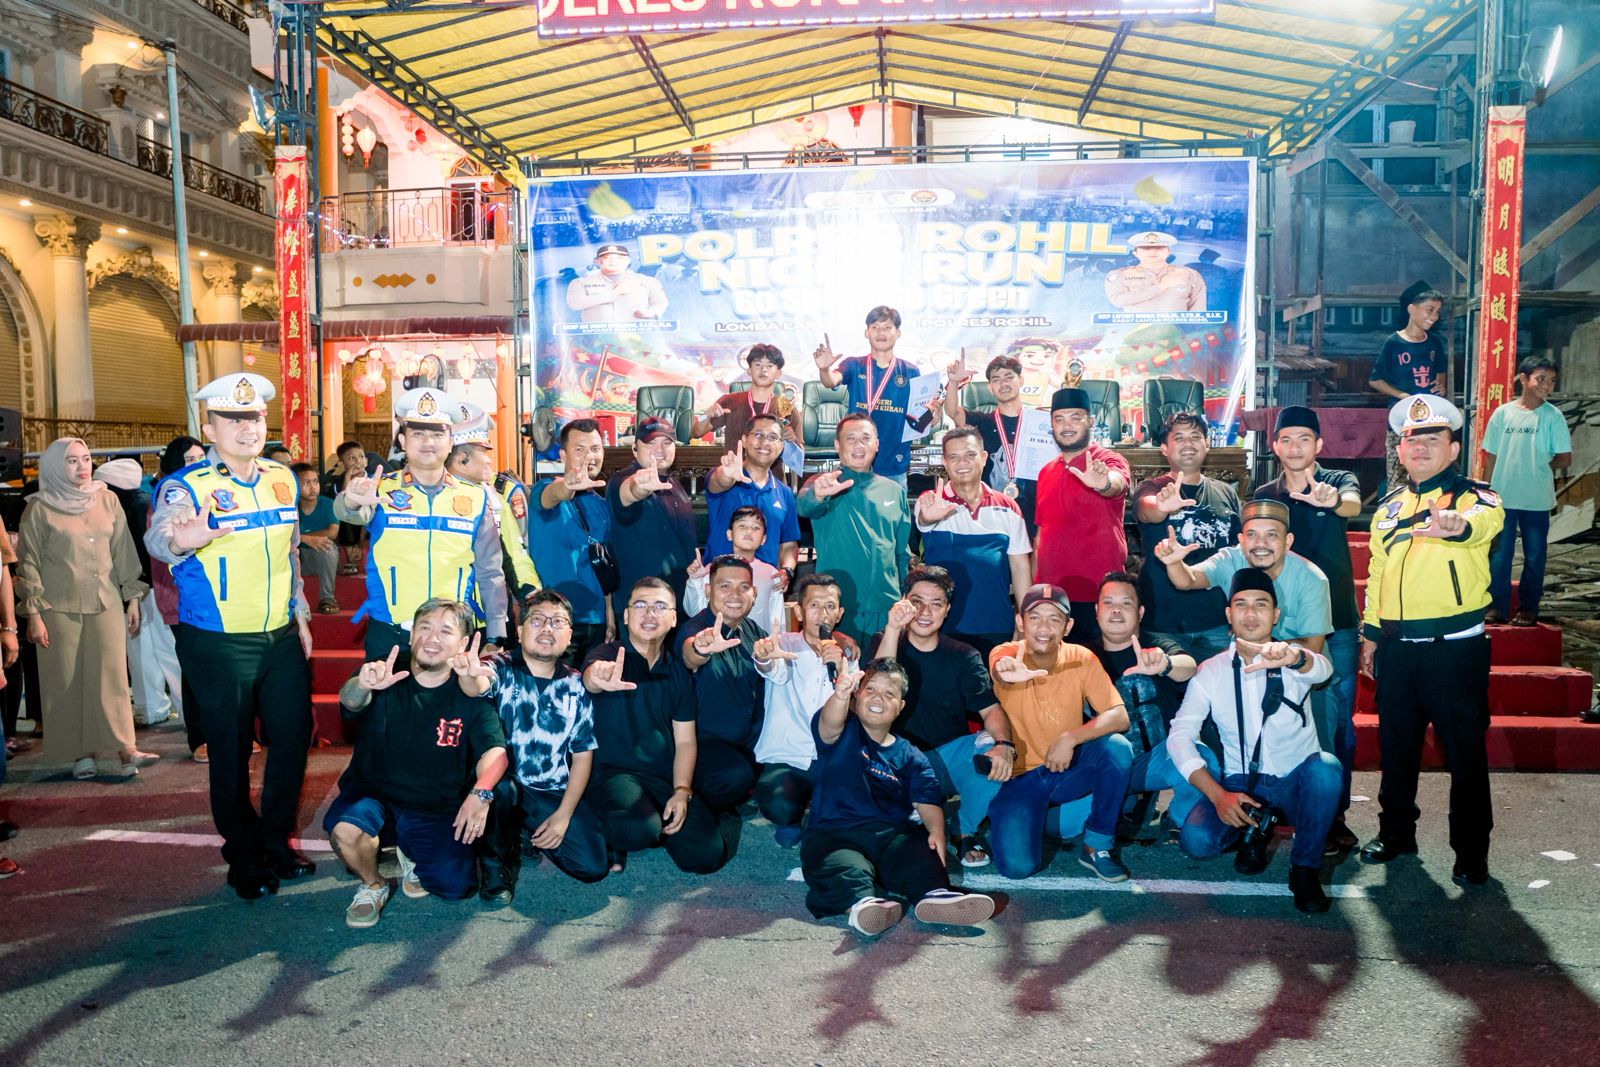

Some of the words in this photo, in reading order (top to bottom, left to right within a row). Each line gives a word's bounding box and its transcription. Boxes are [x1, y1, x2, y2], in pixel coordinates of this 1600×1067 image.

[637, 222, 902, 264] POLR
[919, 221, 1128, 253] ROHIL
[923, 252, 1065, 283] RUN
[716, 322, 780, 332] LOMBA
[922, 317, 991, 327] POLRES
[994, 317, 1050, 327] ROHIL
[1398, 352, 1411, 365] 10
[1023, 386, 1040, 394] 07
